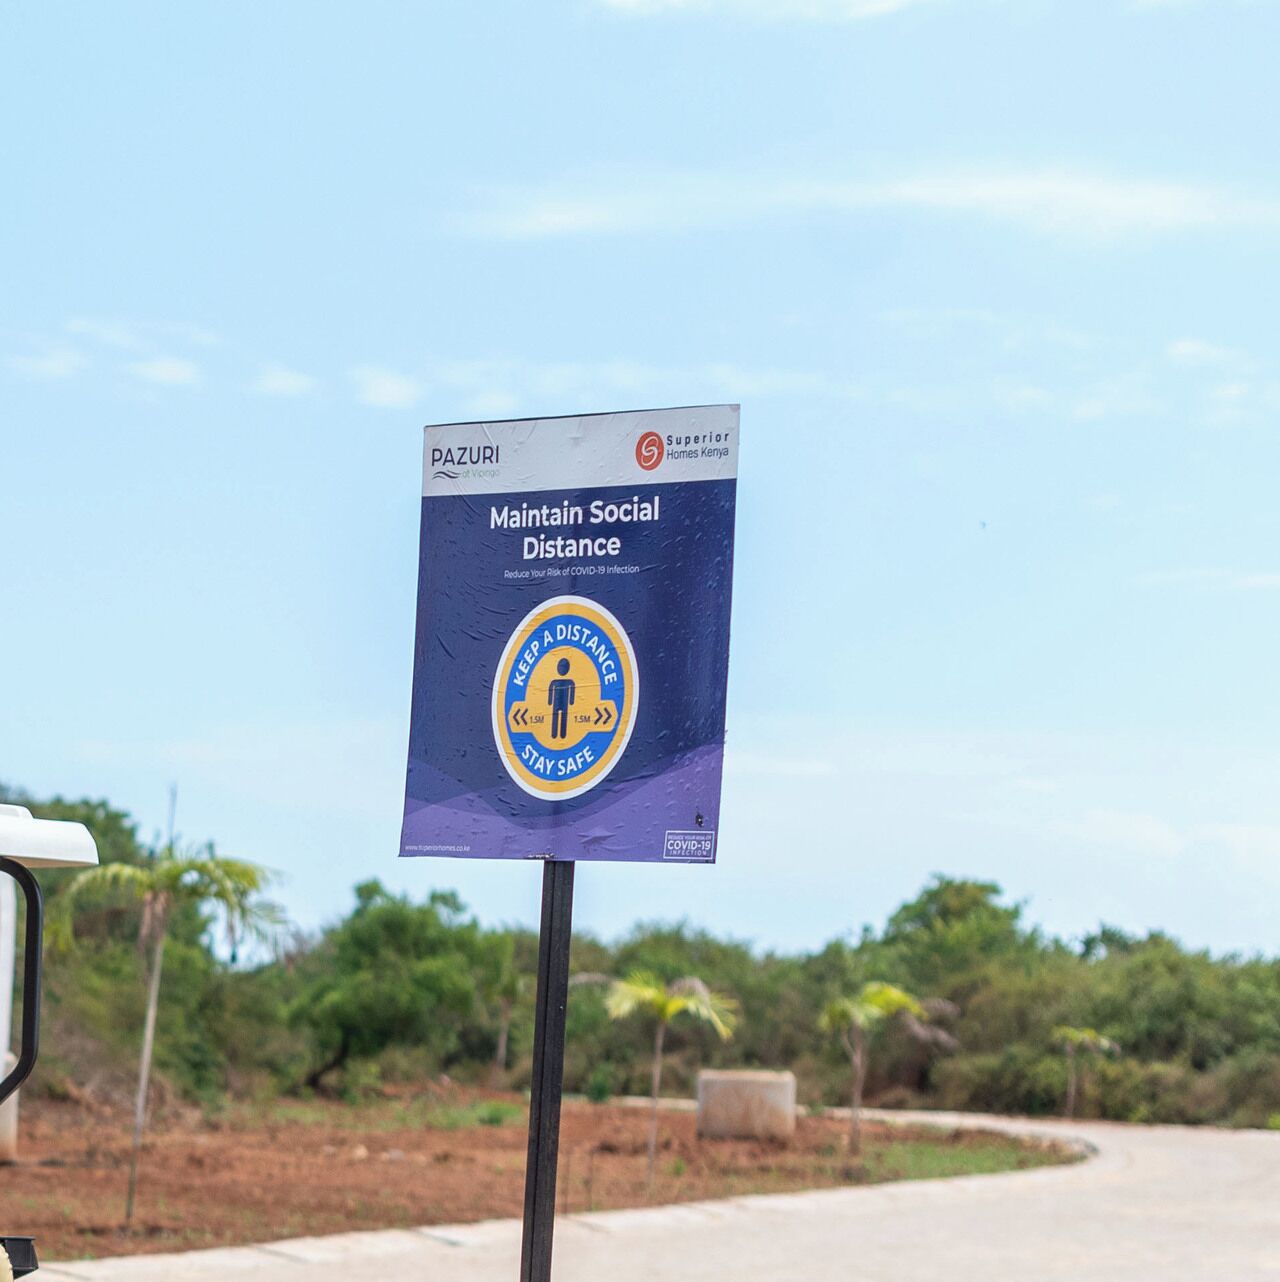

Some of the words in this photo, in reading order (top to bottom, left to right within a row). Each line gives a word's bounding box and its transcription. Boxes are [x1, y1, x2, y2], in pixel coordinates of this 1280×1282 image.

[666, 431, 729, 447] Superior
[431, 445, 499, 467] PAZURI
[666, 448, 699, 460] Homes
[701, 447, 729, 459] Kenya
[490, 500, 583, 530] Maintain
[590, 496, 660, 524] Social
[522, 534, 621, 560] Distance
[504, 569, 530, 579] Reduce
[530, 569, 546, 578] Your
[546, 567, 561, 577] Risk
[570, 565, 606, 576] COVID-19
[606, 564, 640, 574] Infection
[513, 641, 540, 687] KEEP
[543, 630, 554, 647] A
[556, 623, 618, 685] DISTANCE
[574, 715, 591, 724] 1.5M
[521, 744, 555, 775] STAY
[557, 746, 595, 776] SAFE
[667, 840, 711, 850] COVID-19
